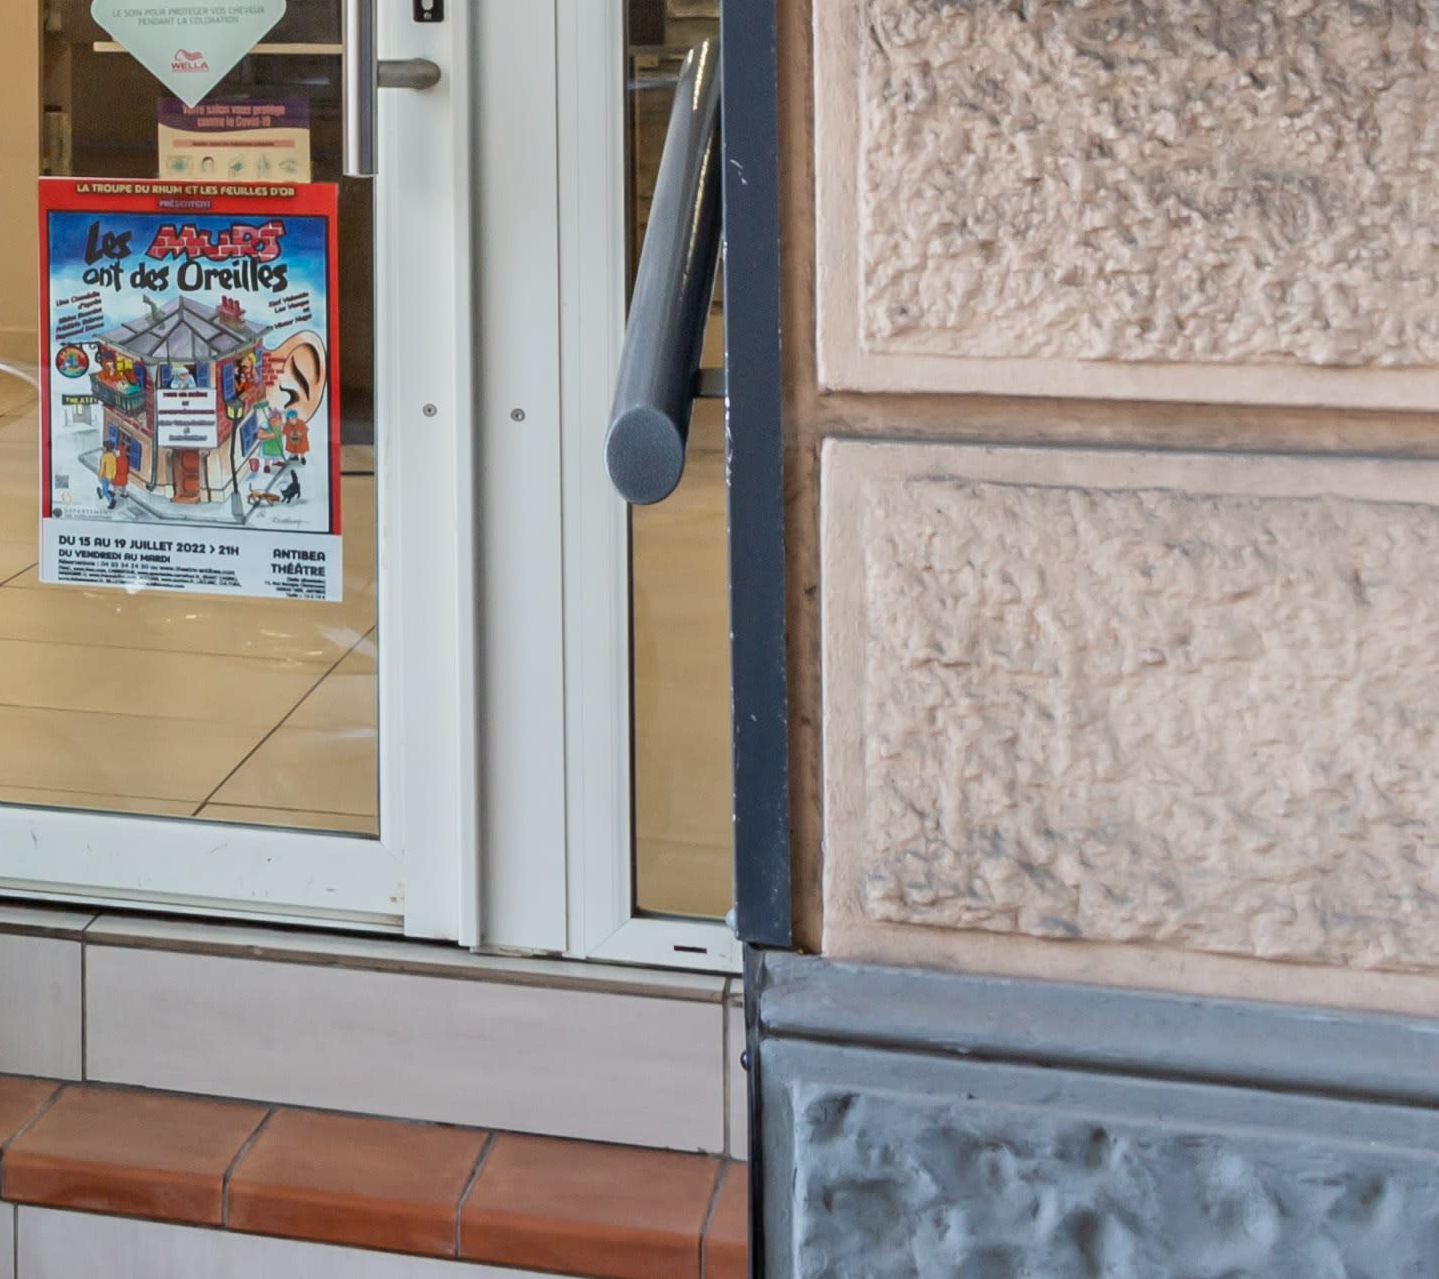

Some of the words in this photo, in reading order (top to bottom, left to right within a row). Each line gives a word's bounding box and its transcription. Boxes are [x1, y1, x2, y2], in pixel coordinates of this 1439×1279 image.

[171, 62, 209, 71] WELLA
[76, 184, 90, 192] LA
[92, 184, 132, 194] TROUPE
[134, 184, 150, 193] DU
[185, 186, 198, 194] ET
[199, 186, 218, 195] LES
[220, 187, 268, 196] FEUILLES
[85, 221, 132, 265] Les
[82, 259, 124, 292] ont
[130, 262, 170, 292] des
[176, 258, 289, 293] Oreilles
[59, 535, 75, 546] DU
[79, 536, 90, 547] 15
[94, 537, 111, 548] AU
[114, 538, 126, 549] 19
[130, 539, 173, 551] JUILLET
[176, 542, 206, 554] 2022
[218, 545, 239, 555] 21H
[59, 549, 72, 558] DU
[74, 549, 122, 560] VENDREDI
[124, 552, 137, 561] AU
[273, 548, 326, 561] ANTIBEA
[271, 562, 325, 577] THÉÂTRE
